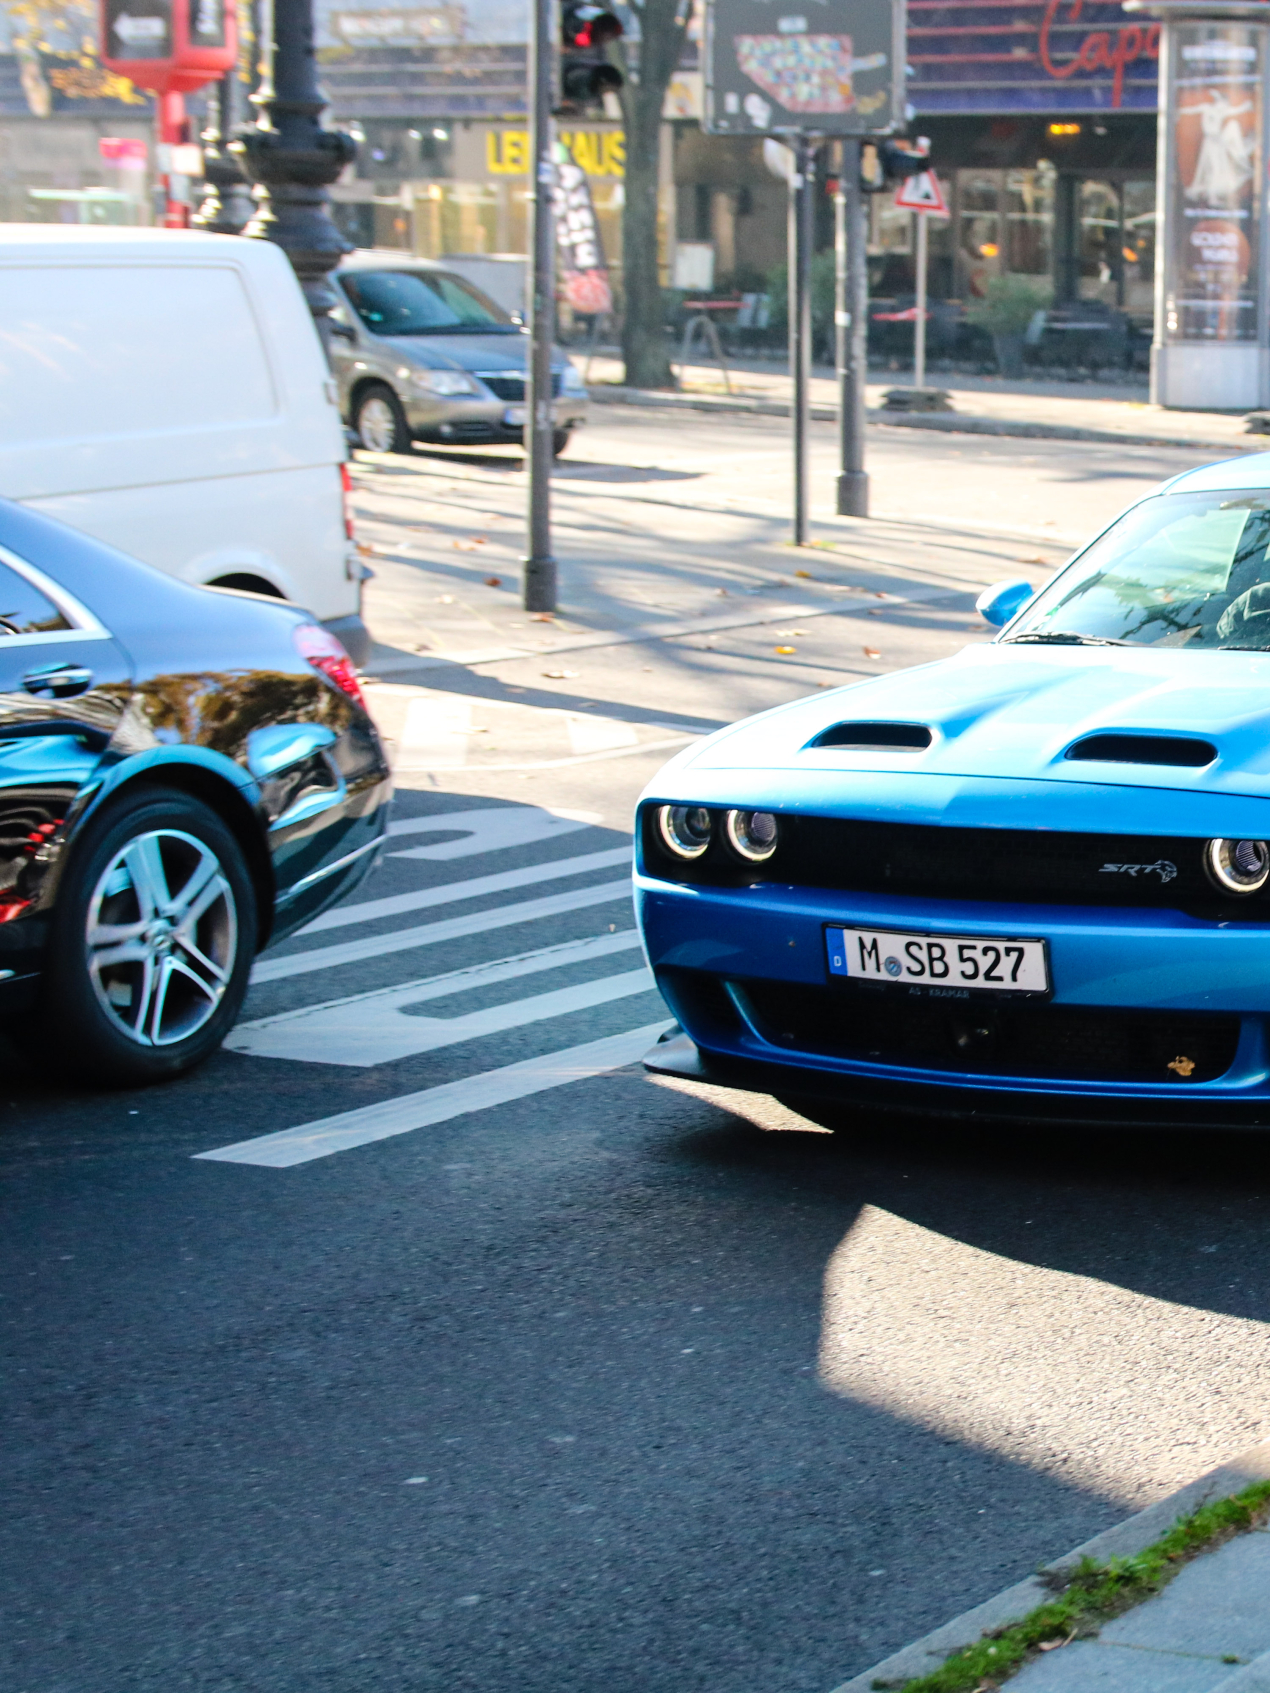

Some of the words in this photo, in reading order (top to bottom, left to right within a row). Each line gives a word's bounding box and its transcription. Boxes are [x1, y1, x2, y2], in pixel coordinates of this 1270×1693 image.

[1098, 863, 1160, 876] SRT
[857, 936, 881, 973] M
[904, 941, 950, 978] SB
[957, 944, 1025, 983] 527
